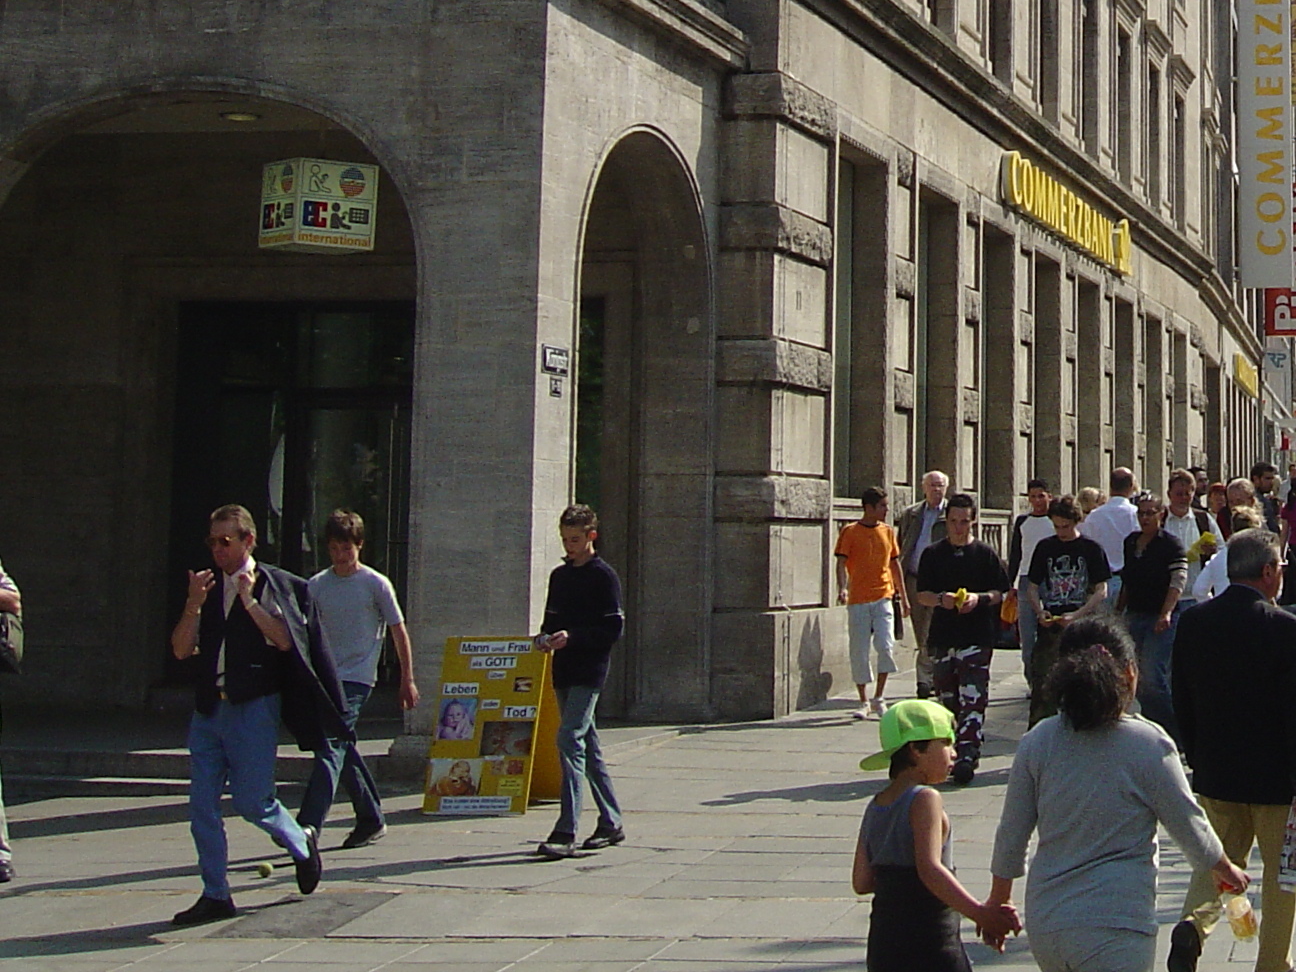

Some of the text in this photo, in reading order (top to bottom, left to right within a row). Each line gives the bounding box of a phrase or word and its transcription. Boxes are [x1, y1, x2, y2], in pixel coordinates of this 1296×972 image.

[1011, 150, 1116, 266] COMMERZBANK
[298, 232, 371, 247] international
[461, 643, 490, 652] Mann
[507, 642, 531, 652] Frau
[485, 657, 516, 667] GOTT
[444, 684, 478, 694] Leben
[506, 707, 527, 717] Tod
